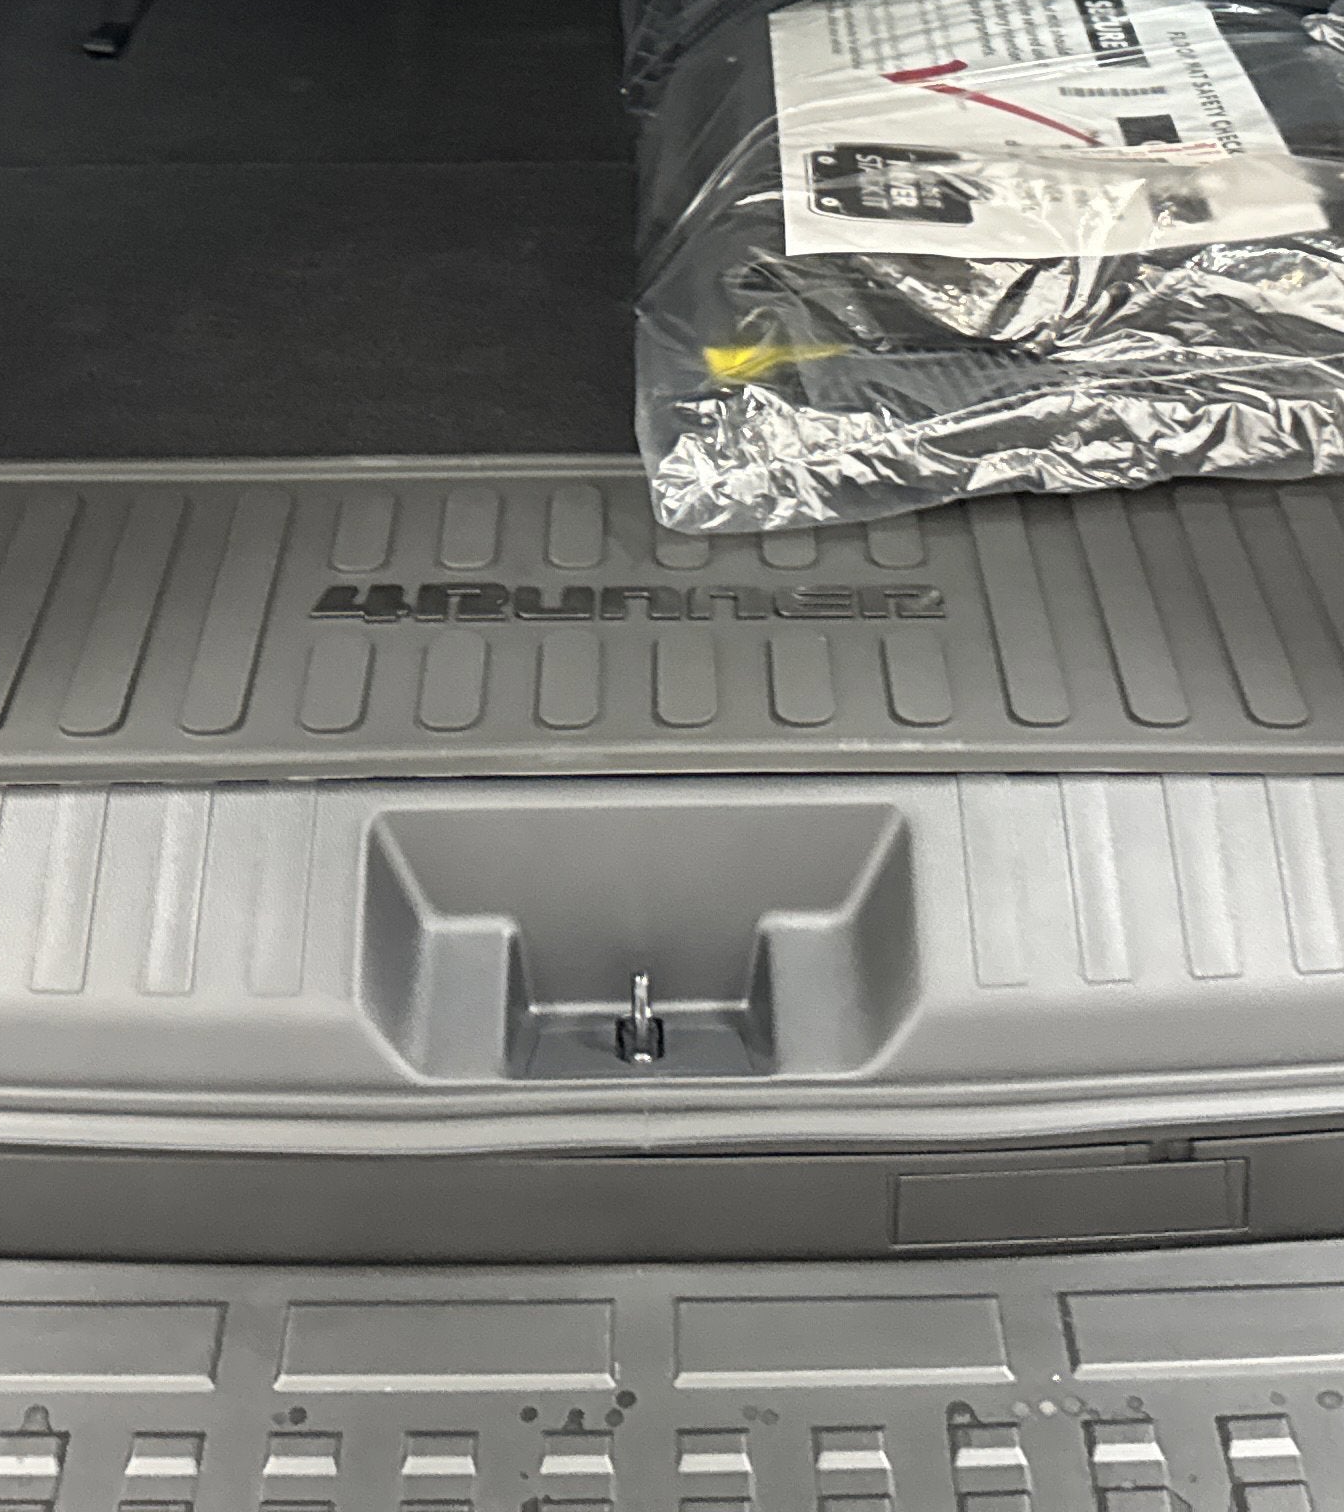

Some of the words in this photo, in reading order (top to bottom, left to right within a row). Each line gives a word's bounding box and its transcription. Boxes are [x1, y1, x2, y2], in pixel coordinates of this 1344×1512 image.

[1192, 82, 1227, 118] SAFETY
[1211, 120, 1246, 155] CHECK
[887, 159, 919, 207] NVER
